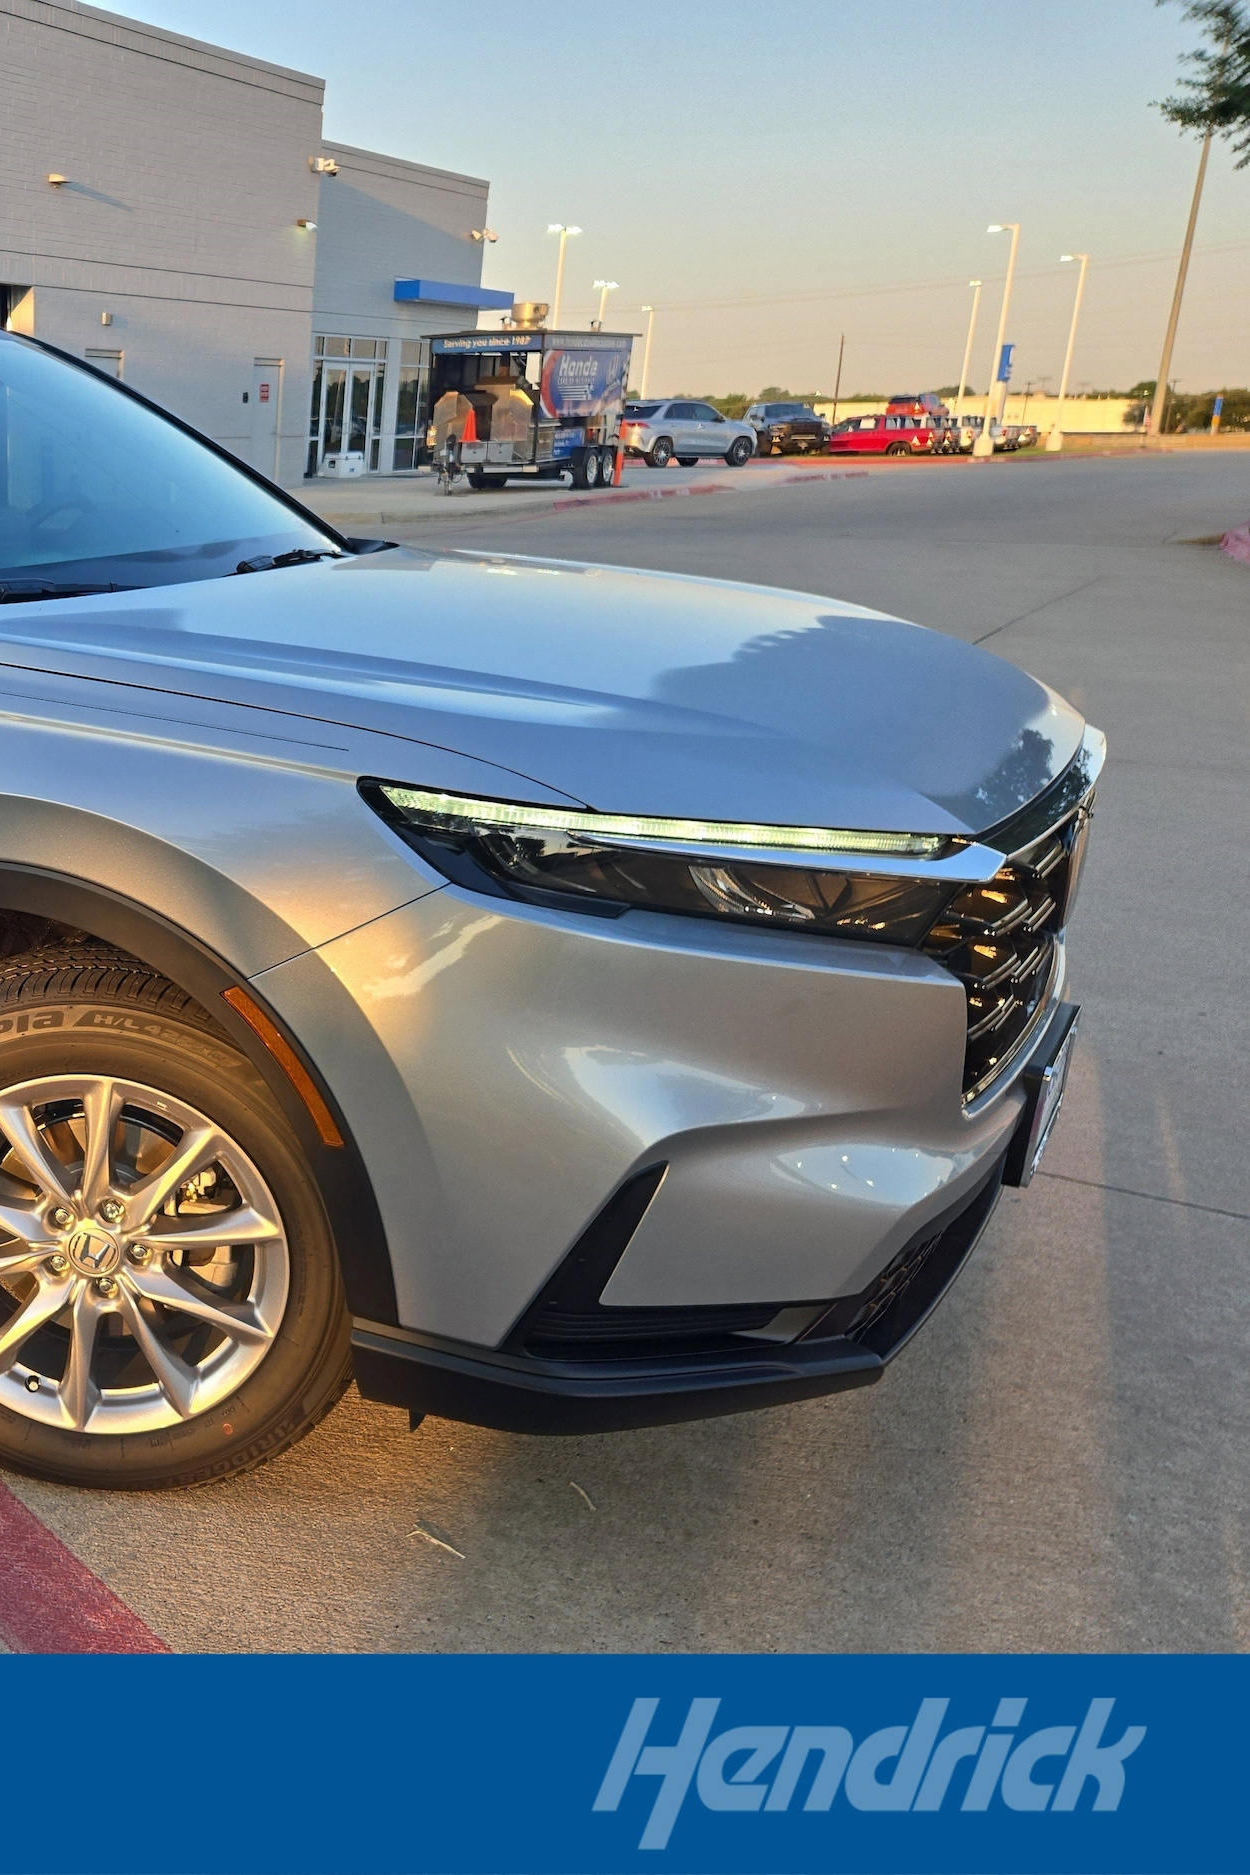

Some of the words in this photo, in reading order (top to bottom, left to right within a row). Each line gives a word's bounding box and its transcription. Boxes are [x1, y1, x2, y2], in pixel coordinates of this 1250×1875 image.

[443, 338, 472, 349] Serving
[472, 338, 488, 348] you
[489, 337, 510, 347] since
[558, 355, 599, 377] Honda
